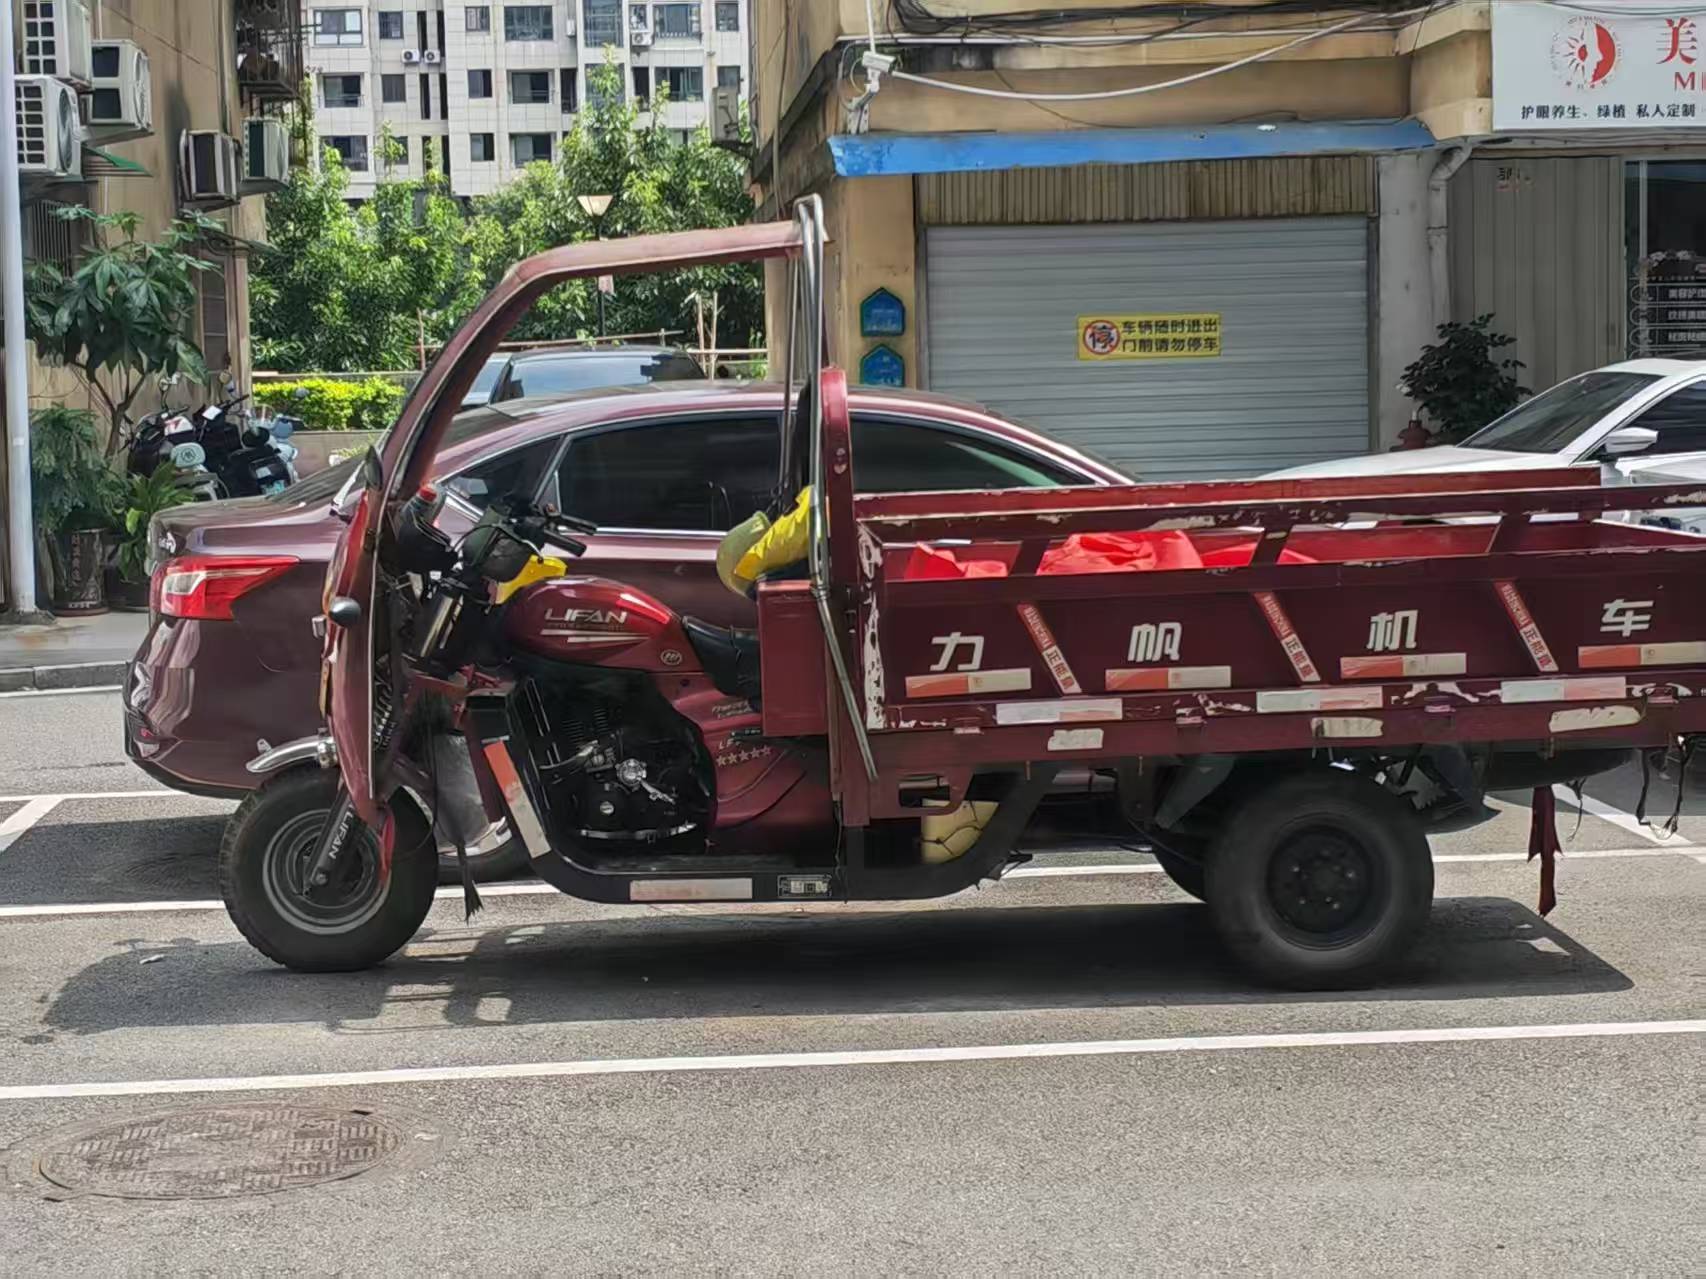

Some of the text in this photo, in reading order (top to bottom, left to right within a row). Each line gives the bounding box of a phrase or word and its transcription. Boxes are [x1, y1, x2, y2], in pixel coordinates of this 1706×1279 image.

[1656, 17, 1697, 65] 美
[1674, 71, 1706, 91] M
[1636, 103, 1696, 119] 私人定制
[1121, 319, 1217, 334] 车辆随时进出
[1122, 337, 1218, 353] 门前请勿停车
[544, 608, 628, 624] LIFAN
[328, 810, 354, 860] LIFAN
